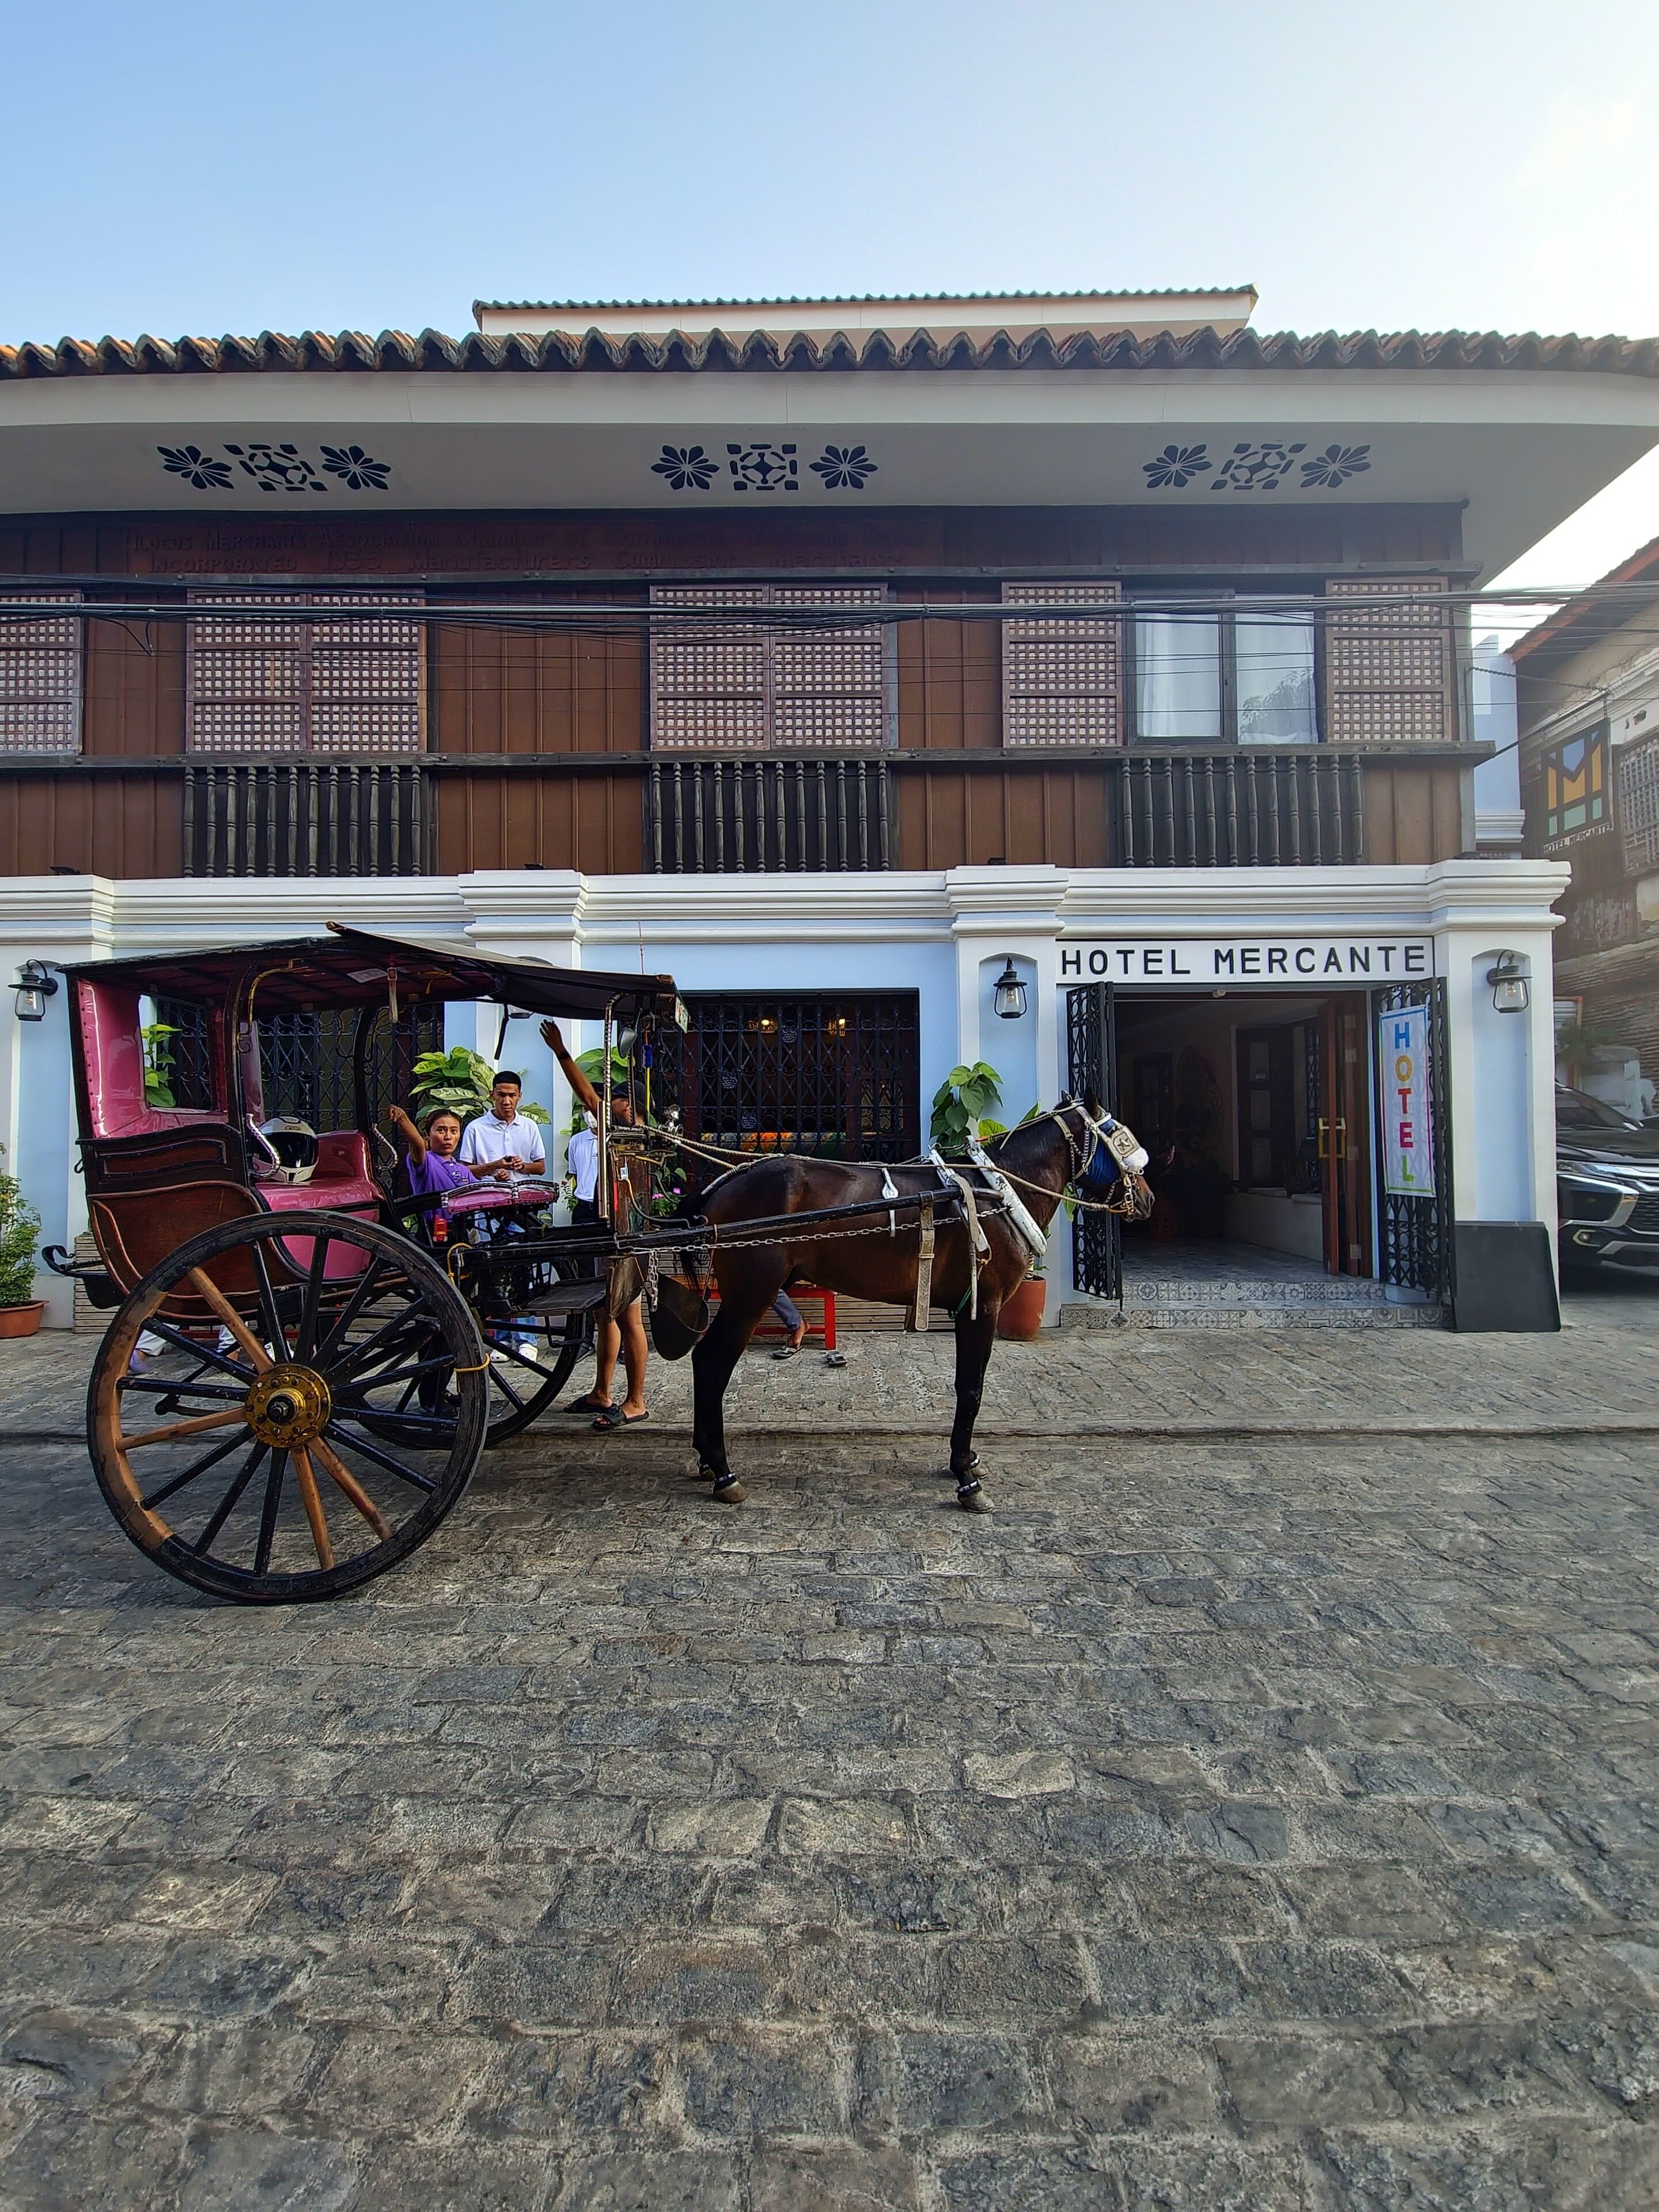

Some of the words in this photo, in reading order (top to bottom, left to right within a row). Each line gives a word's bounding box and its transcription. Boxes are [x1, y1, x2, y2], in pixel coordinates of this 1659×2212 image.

[1062, 949, 1191, 975] HOTEL
[1214, 945, 1426, 974] MERCANTE
[1394, 1021, 1414, 1182] HOTEL
